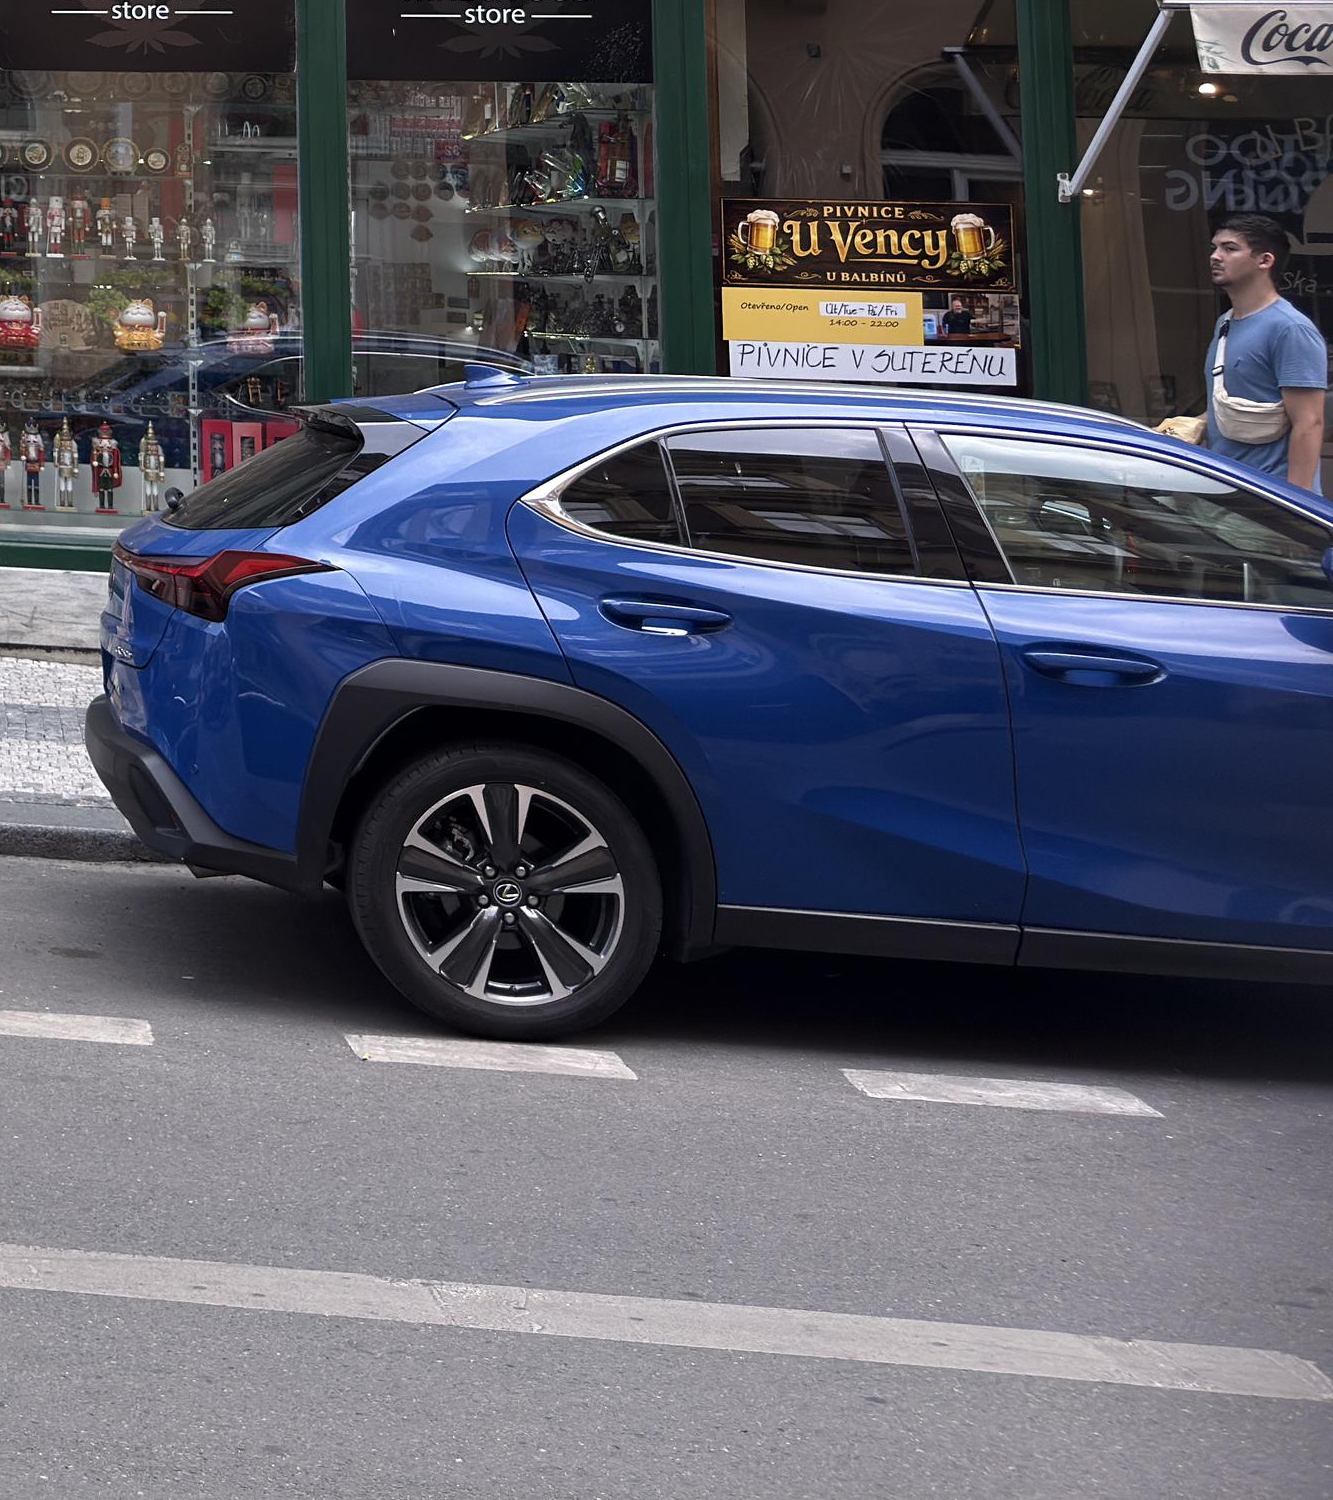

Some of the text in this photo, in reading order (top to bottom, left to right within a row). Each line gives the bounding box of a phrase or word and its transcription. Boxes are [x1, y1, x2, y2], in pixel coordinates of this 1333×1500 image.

[111, 2, 169, 20] store
[464, 5, 525, 24] store
[823, 206, 904, 218] PIVNICE
[783, 219, 947, 269] U Vency
[826, 270, 906, 283] U BALBÍNŮ
[741, 302, 809, 313] Otevřeno/Open
[829, 319, 857, 327] 14:00
[870, 320, 899, 328] 22:00
[871, 348, 1006, 377] SUTERÉNU
